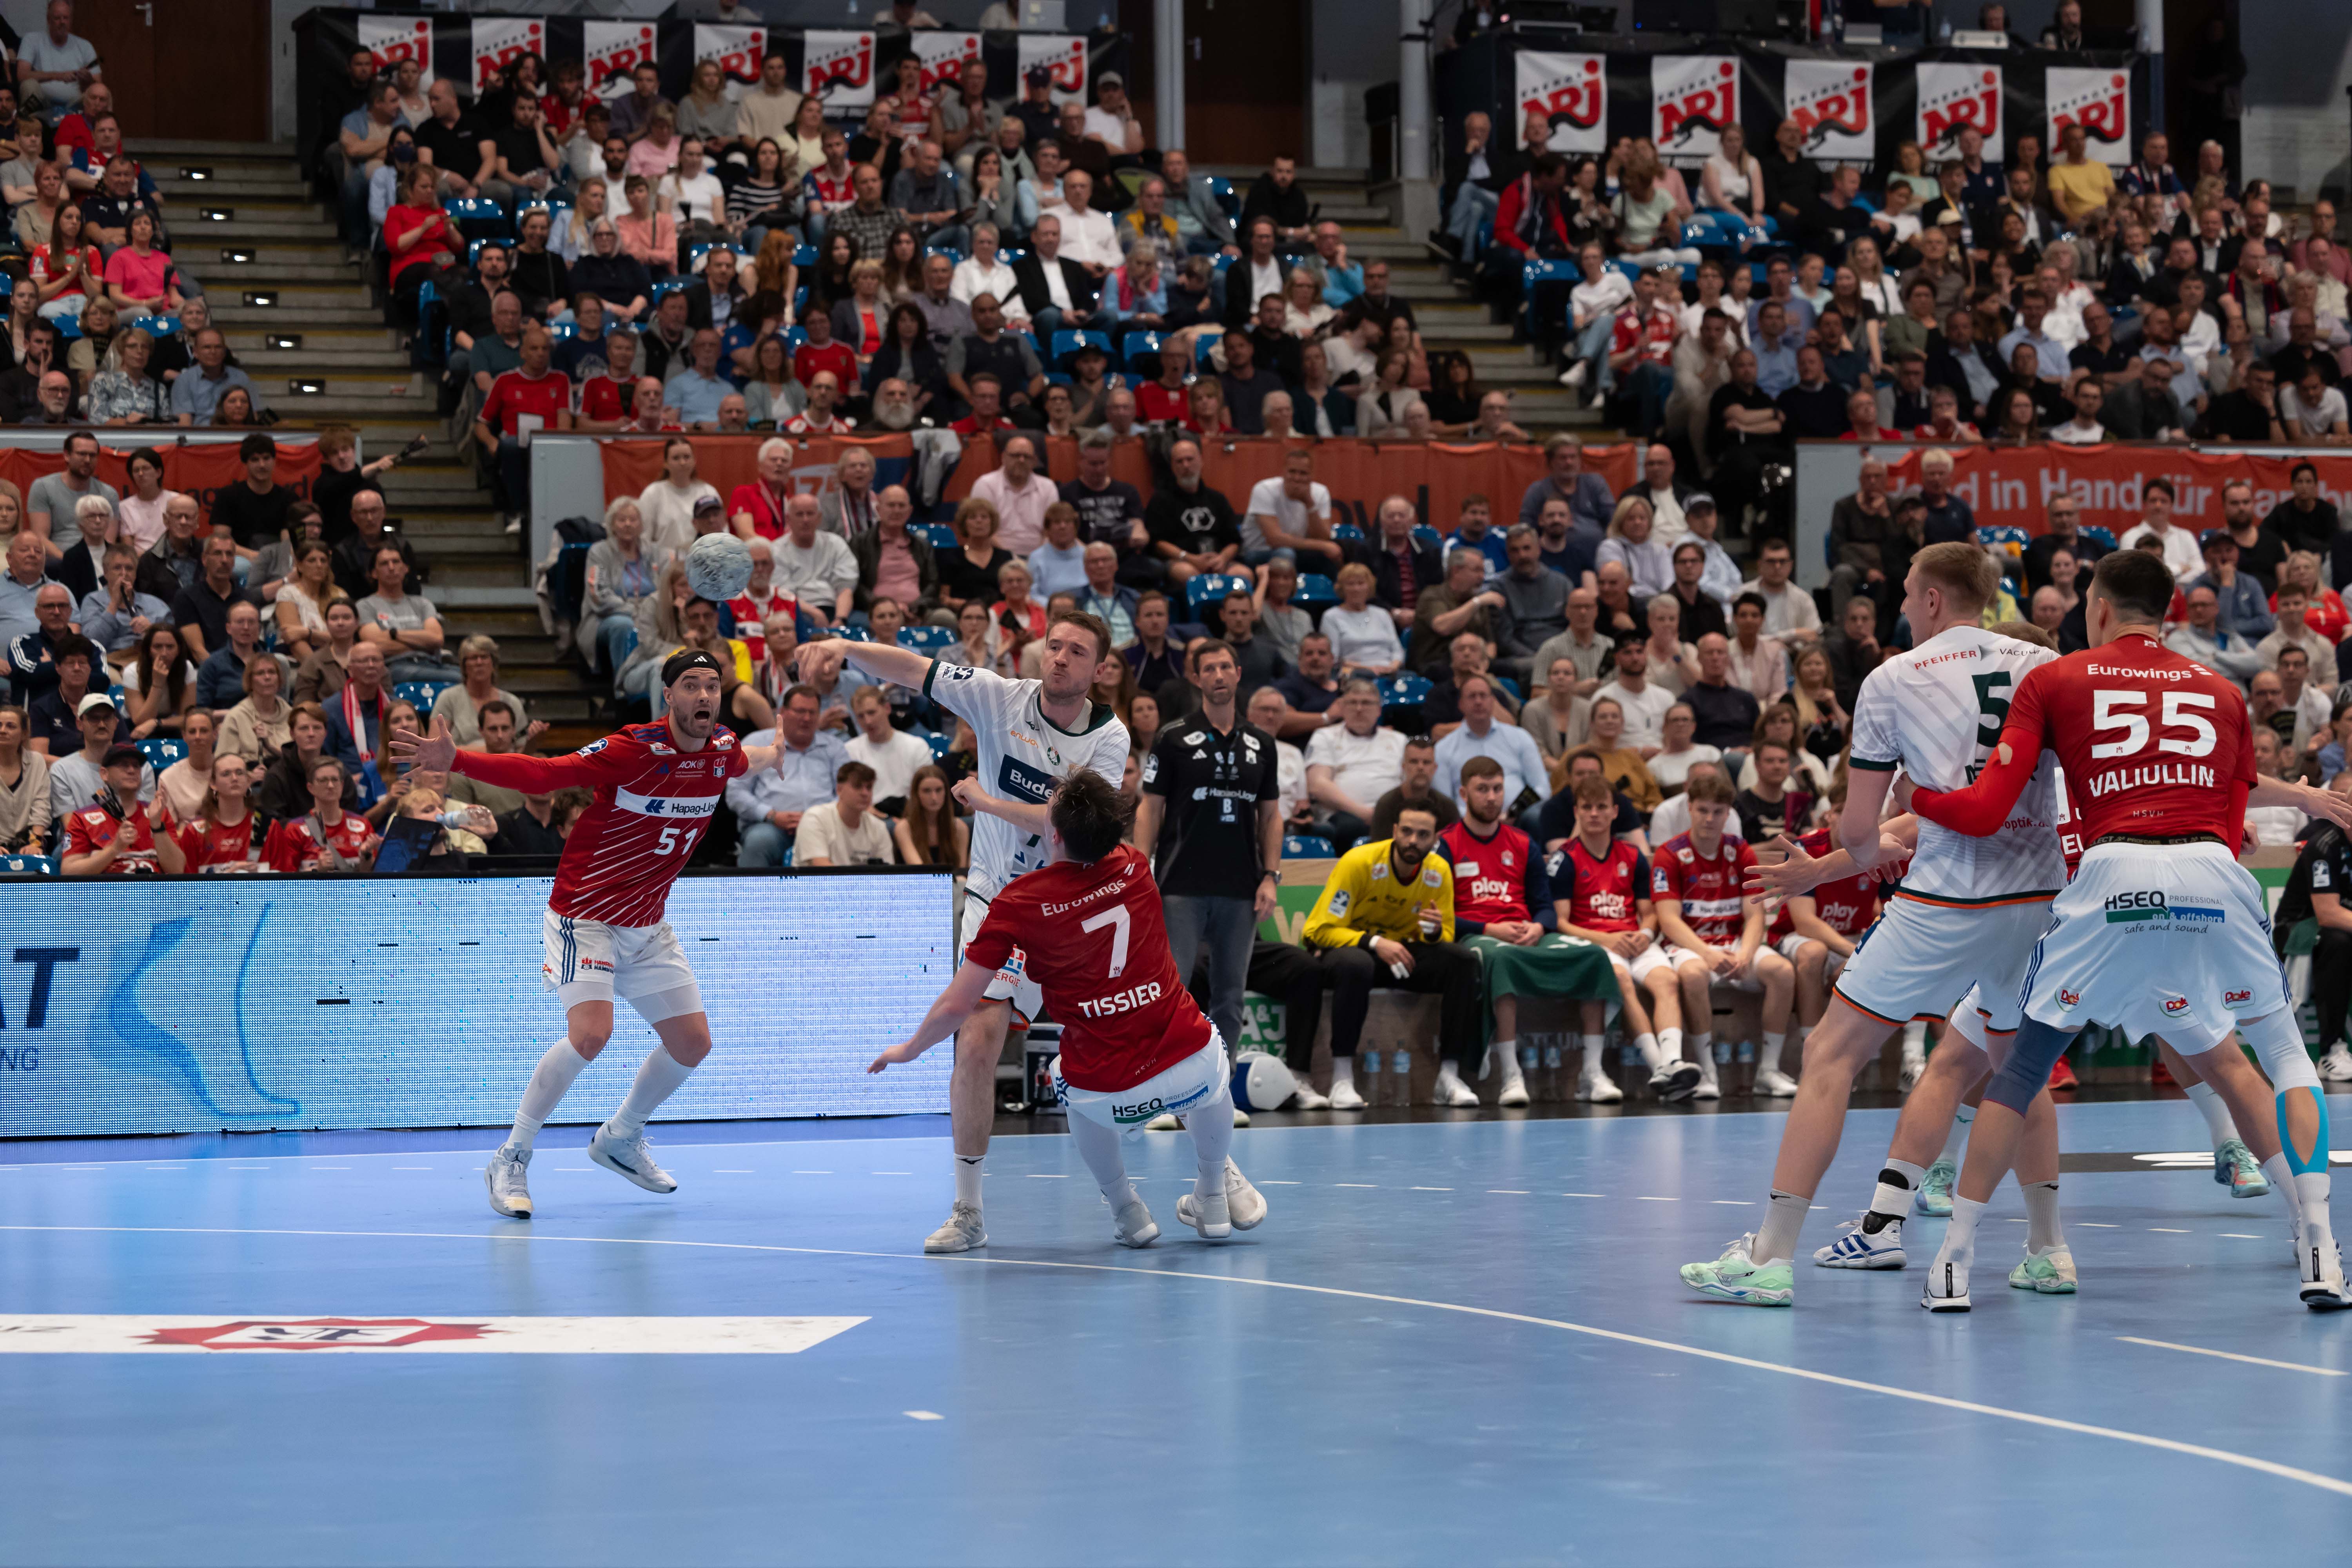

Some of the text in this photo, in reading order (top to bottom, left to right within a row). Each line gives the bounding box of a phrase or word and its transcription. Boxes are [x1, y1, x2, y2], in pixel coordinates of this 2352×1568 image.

[1990, 472, 2027, 511] in
[1914, 650, 1977, 670] PFEIFFER
[2087, 664, 2192, 681] Eurowings
[2091, 690, 2217, 759] 55
[677, 760, 697, 769] AOK
[2089, 764, 2214, 797] VALIULLIN
[1223, 798, 1232, 813] B
[653, 827, 698, 855] 51
[1041, 879, 1127, 916] Eurowings
[1471, 877, 1509, 898] play
[1821, 901, 1859, 920] play
[2104, 890, 2224, 911] HSEQ PROFESSIONAL
[2125, 922, 2209, 934] safe and sound
[2180, 912, 2223, 923] offshore
[1081, 904, 1131, 978] 7
[994, 971, 1021, 987] ERGIE
[1078, 982, 1161, 1018] TISSIER
[2225, 989, 2251, 1002] Dole
[1112, 1080, 1207, 1117] HSEQ PROFESSIONAL
